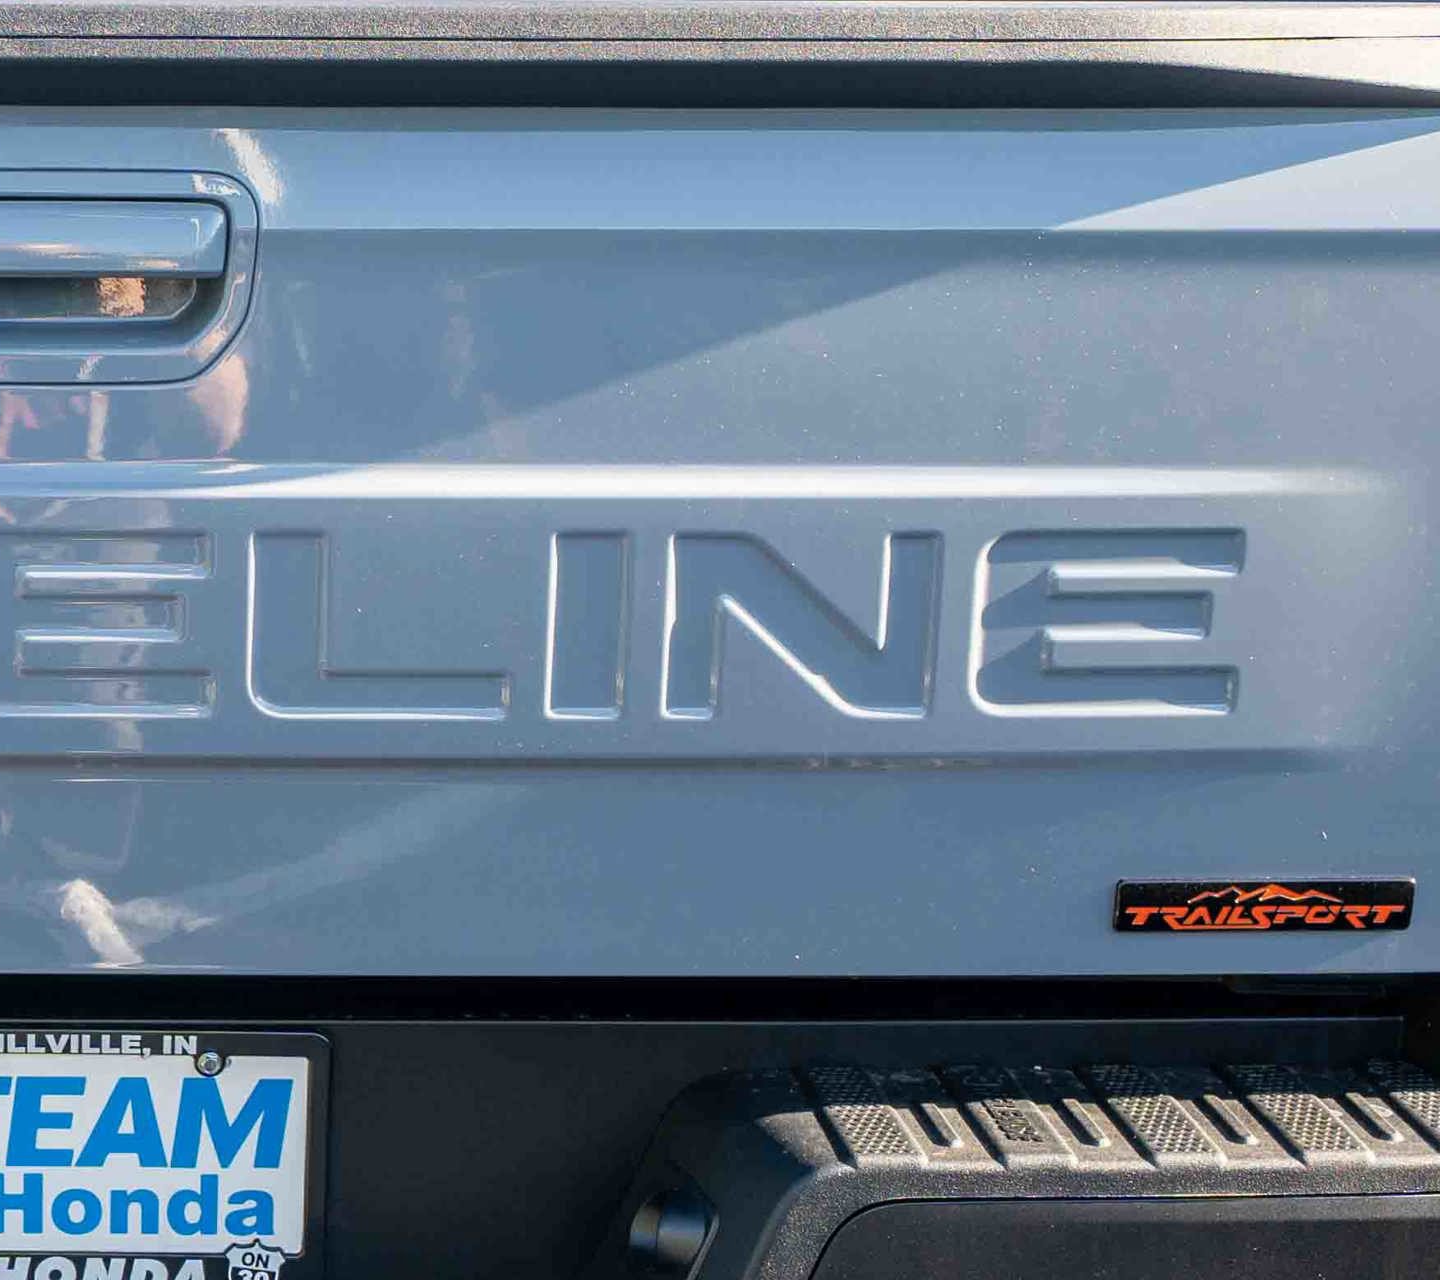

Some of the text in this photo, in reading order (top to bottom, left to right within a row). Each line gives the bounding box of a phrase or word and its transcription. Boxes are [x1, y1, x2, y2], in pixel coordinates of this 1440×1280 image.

[1125, 905, 1406, 930] TRAILSPORT
[163, 1035, 198, 1055] IN
[241, 1252, 270, 1269] ON
